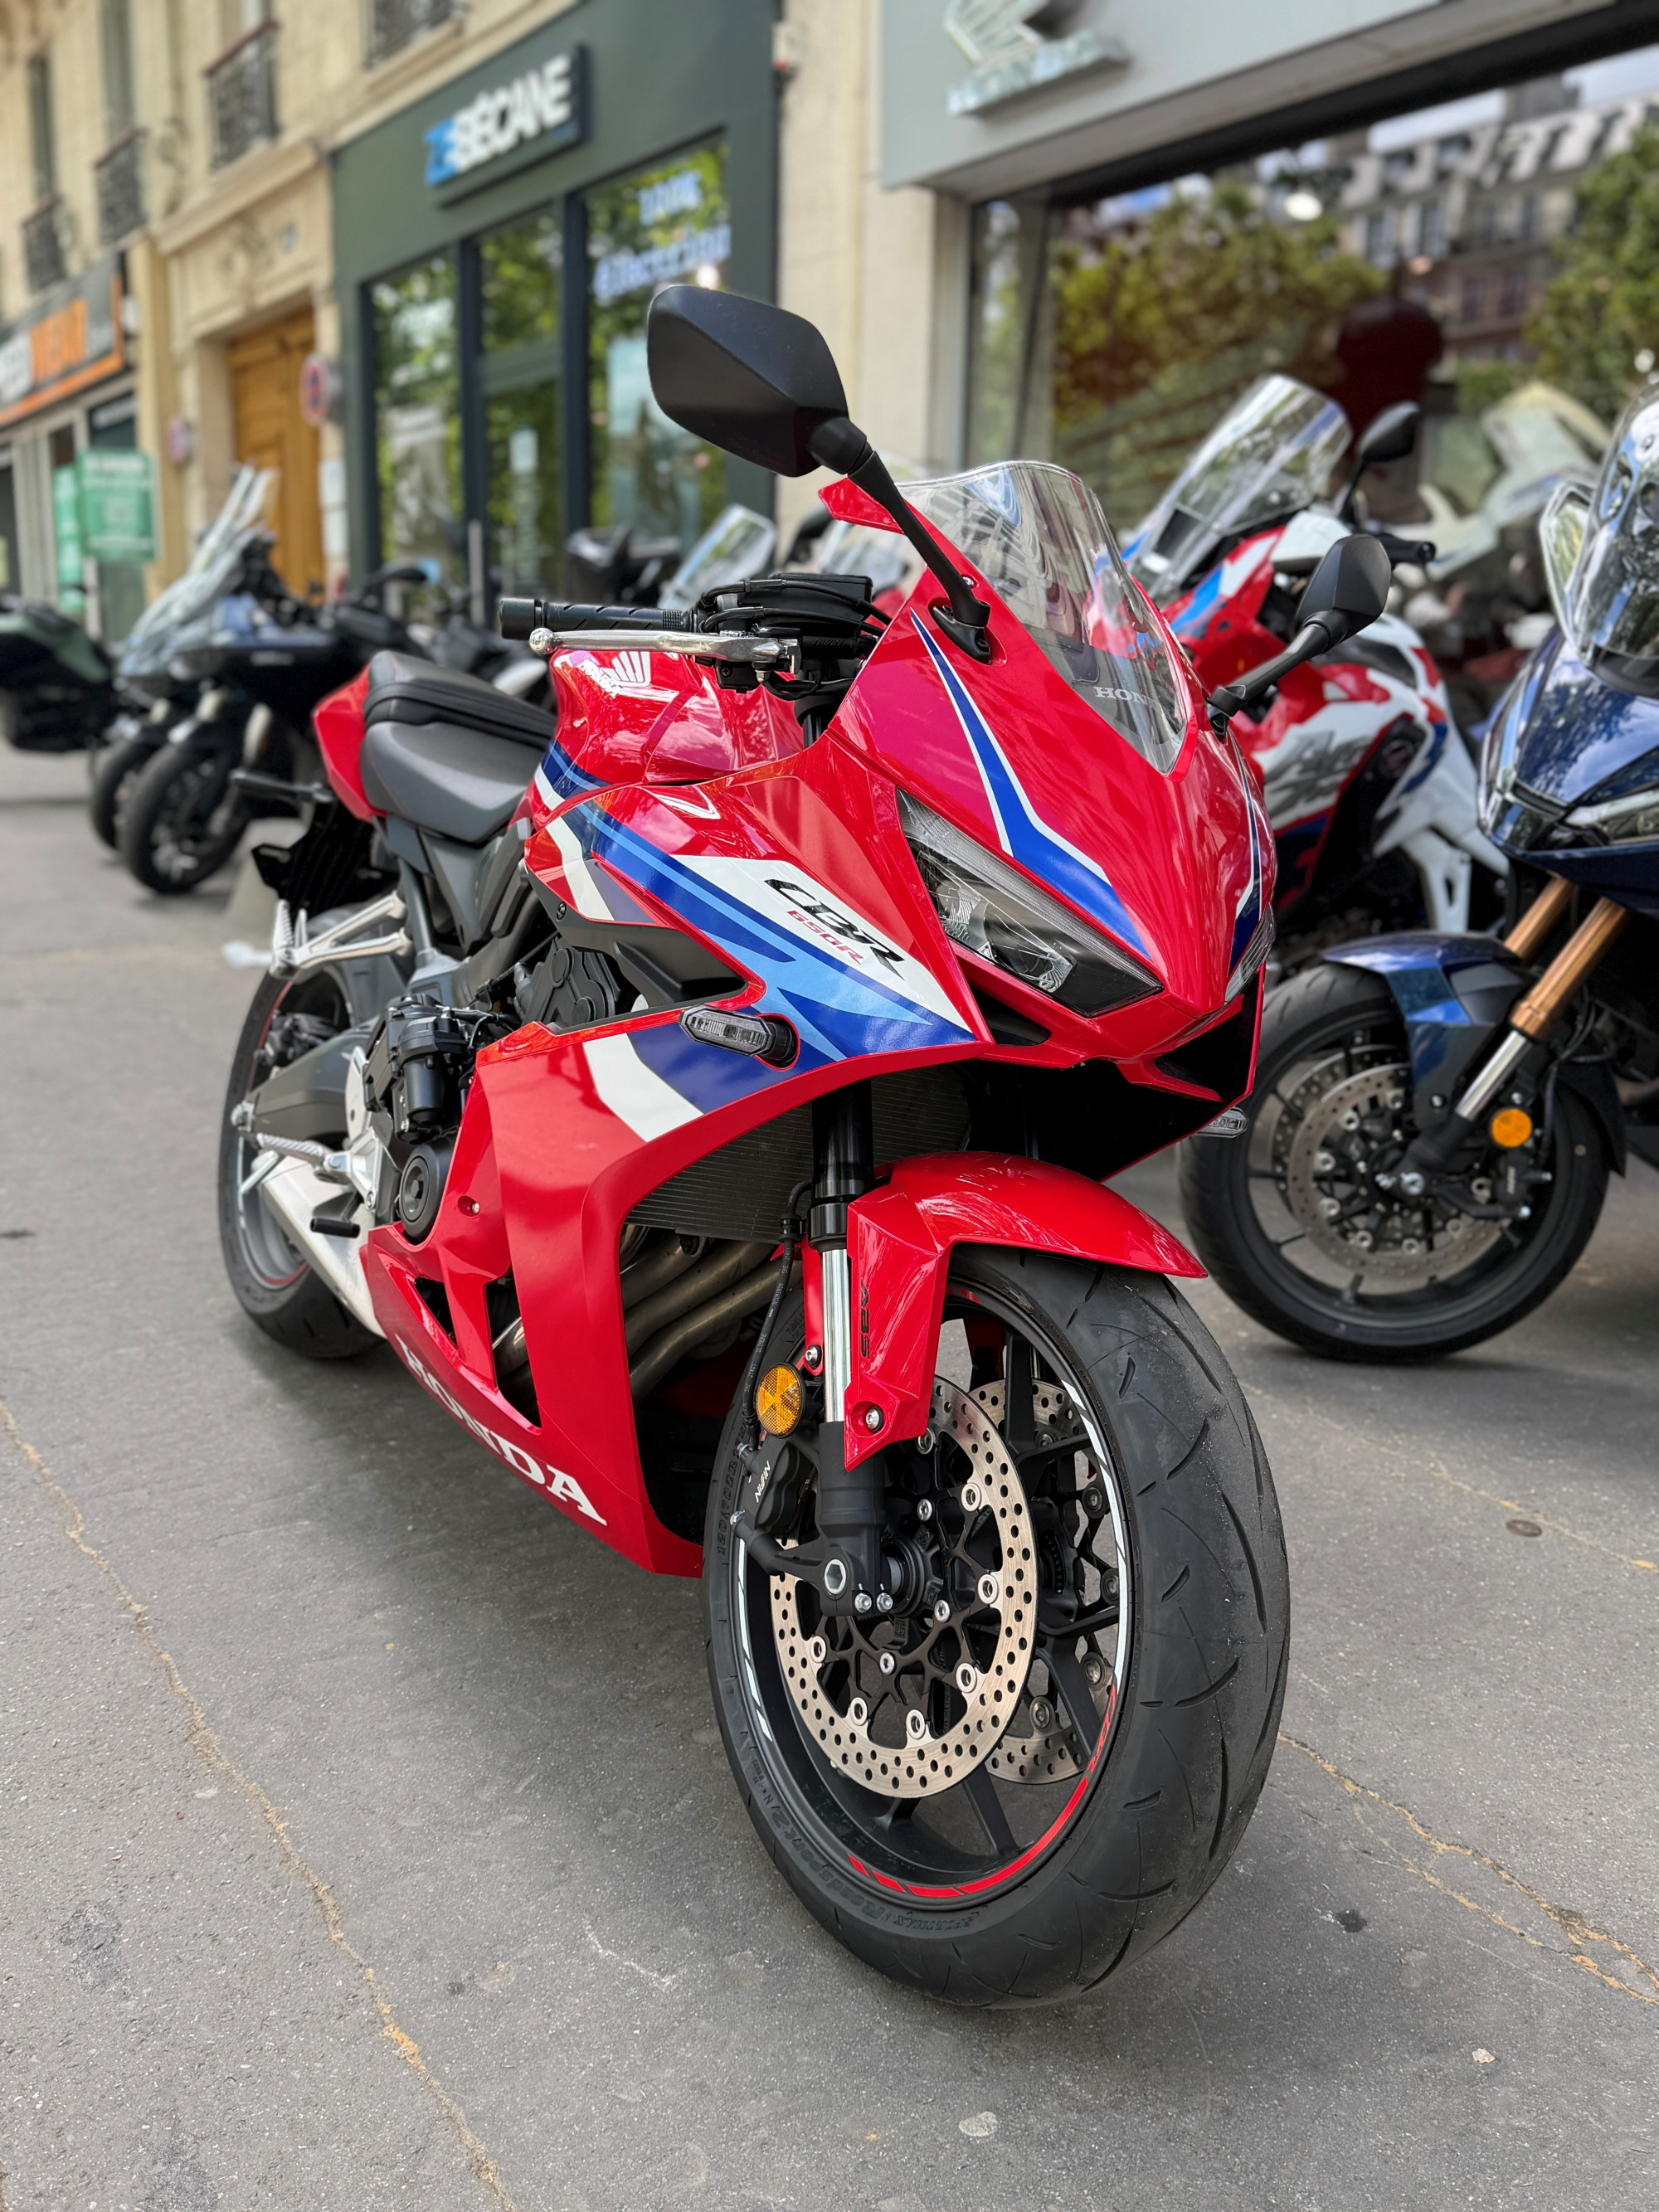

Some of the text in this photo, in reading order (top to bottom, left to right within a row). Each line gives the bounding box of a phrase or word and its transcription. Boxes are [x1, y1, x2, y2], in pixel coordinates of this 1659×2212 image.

[764, 878, 905, 981] CBR
[786, 910, 864, 965] 650R
[394, 1332, 608, 1527] HONDA
